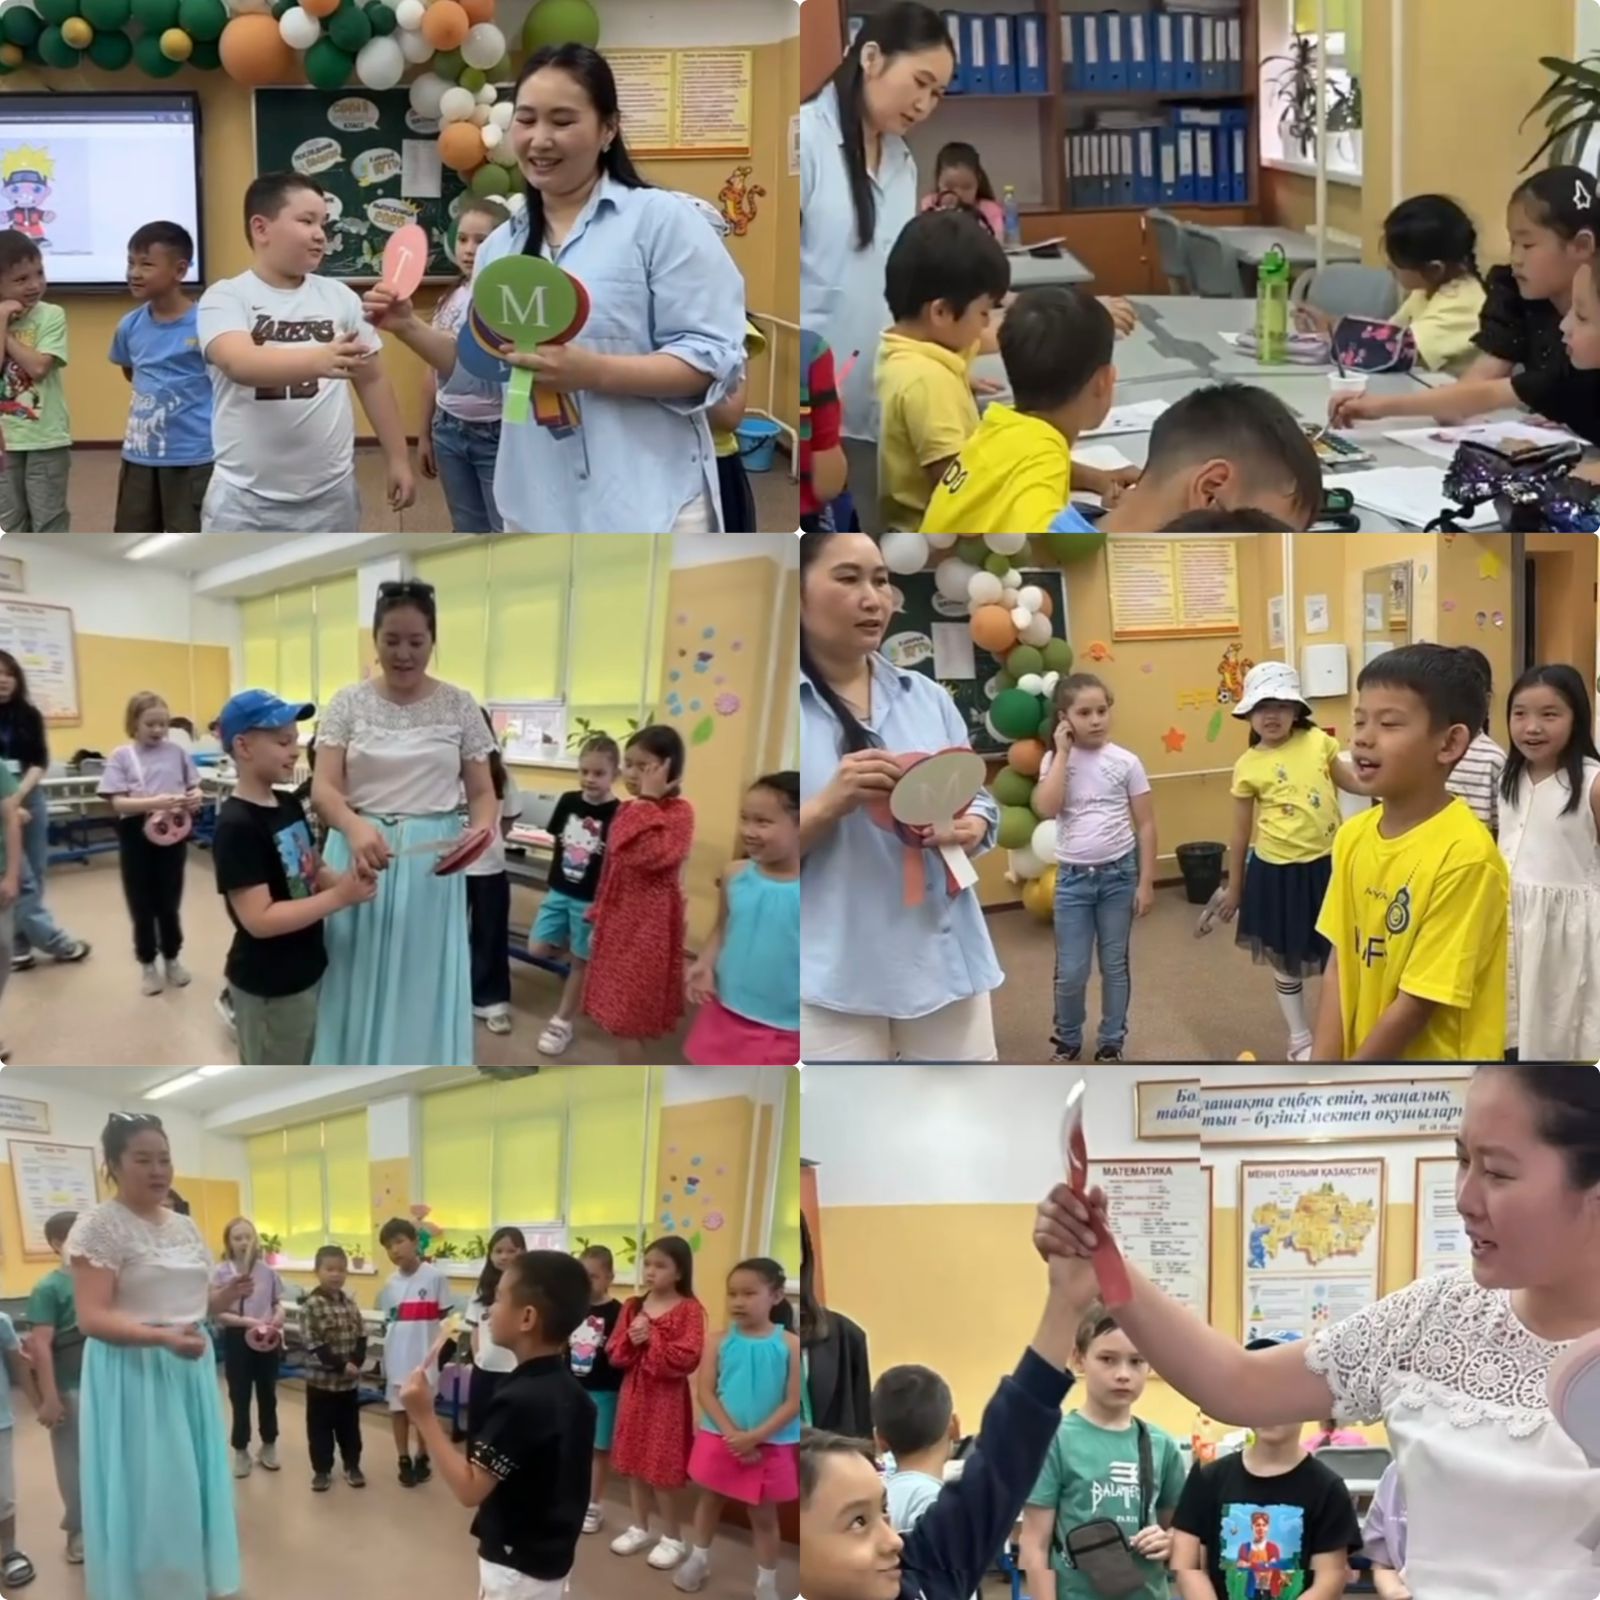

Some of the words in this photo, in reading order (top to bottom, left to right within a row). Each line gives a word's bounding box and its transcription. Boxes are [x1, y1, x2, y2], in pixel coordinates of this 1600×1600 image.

[497, 283, 549, 328] M
[1278, 1092, 1322, 1109] еңбек
[1327, 1090, 1368, 1106] етіп,
[1371, 1090, 1450, 1106] жаңалық
[1255, 1108, 1306, 1128] бүгінгі
[1309, 1109, 1371, 1124] мектеп
[1102, 1166, 1173, 1177] МАТЕМАТИКА
[1278, 1168, 1319, 1178] ОТАНЫМ
